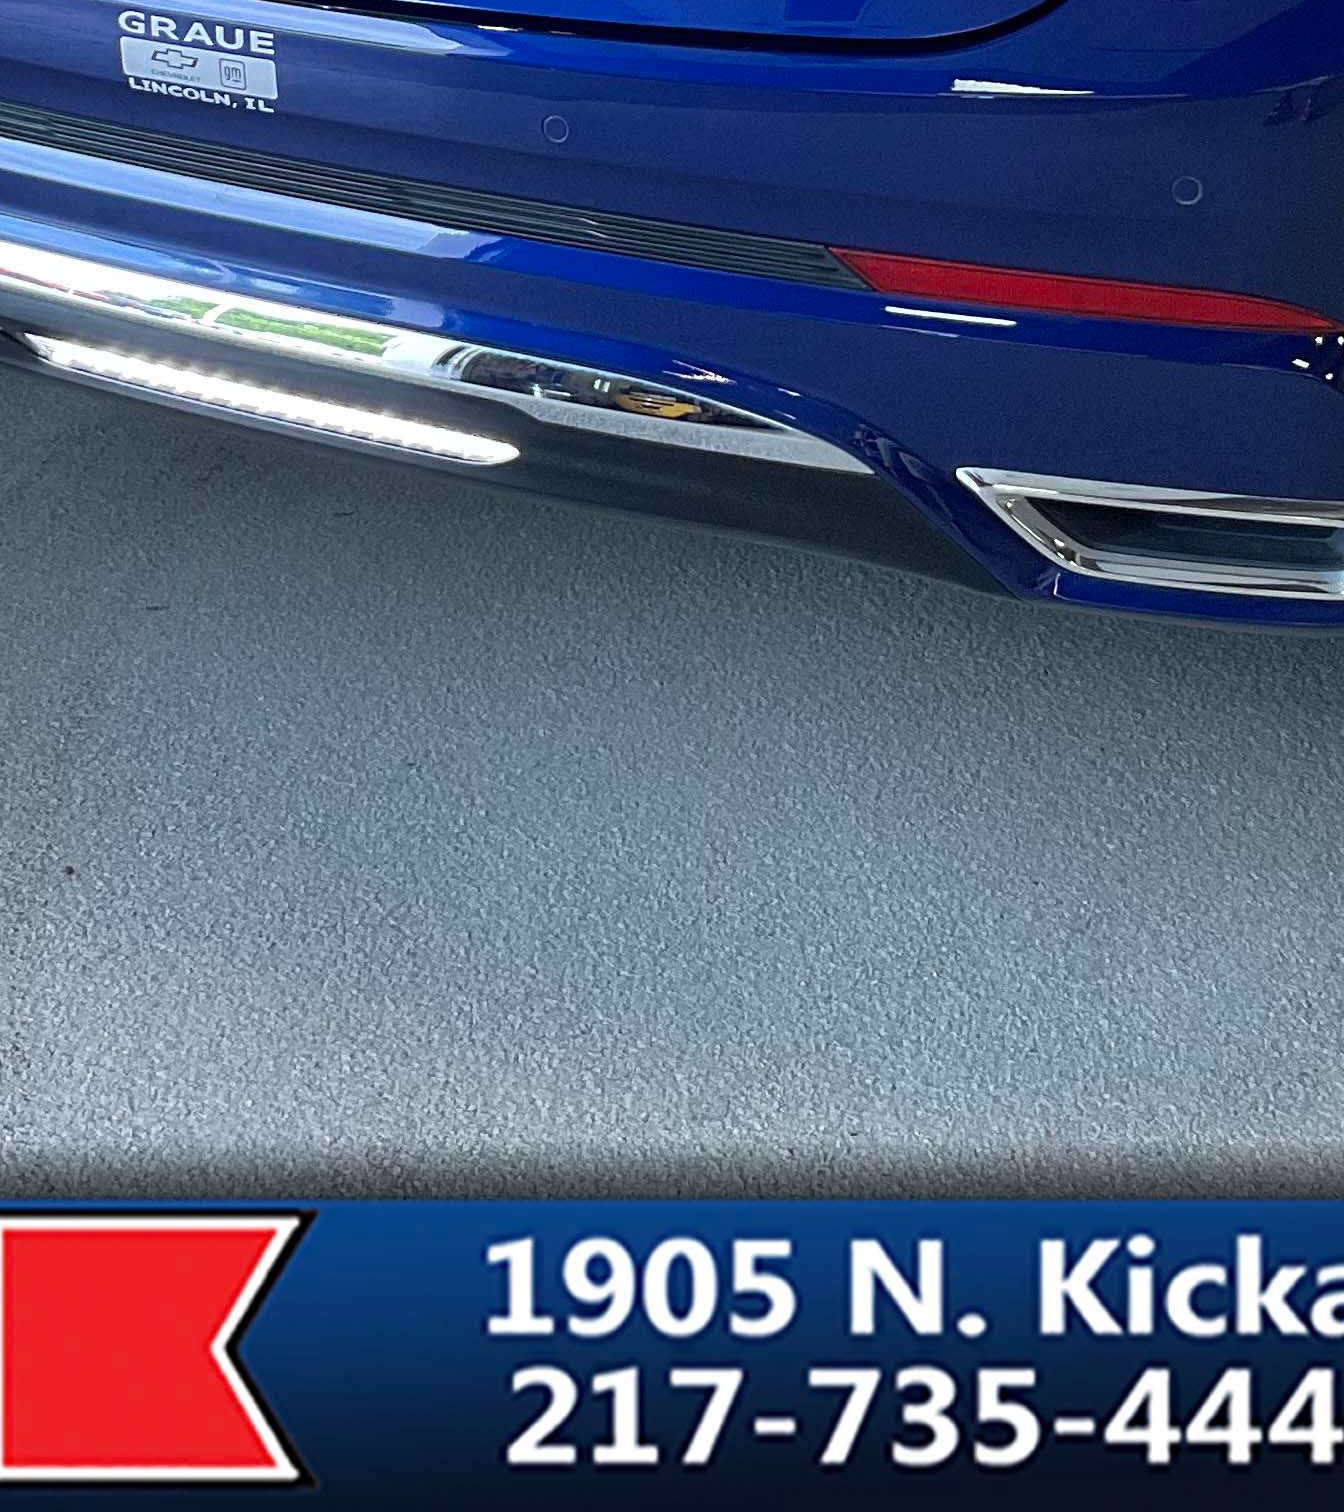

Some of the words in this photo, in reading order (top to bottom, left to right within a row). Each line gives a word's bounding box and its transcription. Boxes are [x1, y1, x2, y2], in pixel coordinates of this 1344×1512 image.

[118, 10, 275, 56] GRAUE
[128, 77, 238, 109] LINCOLN,
[244, 97, 275, 114] IL
